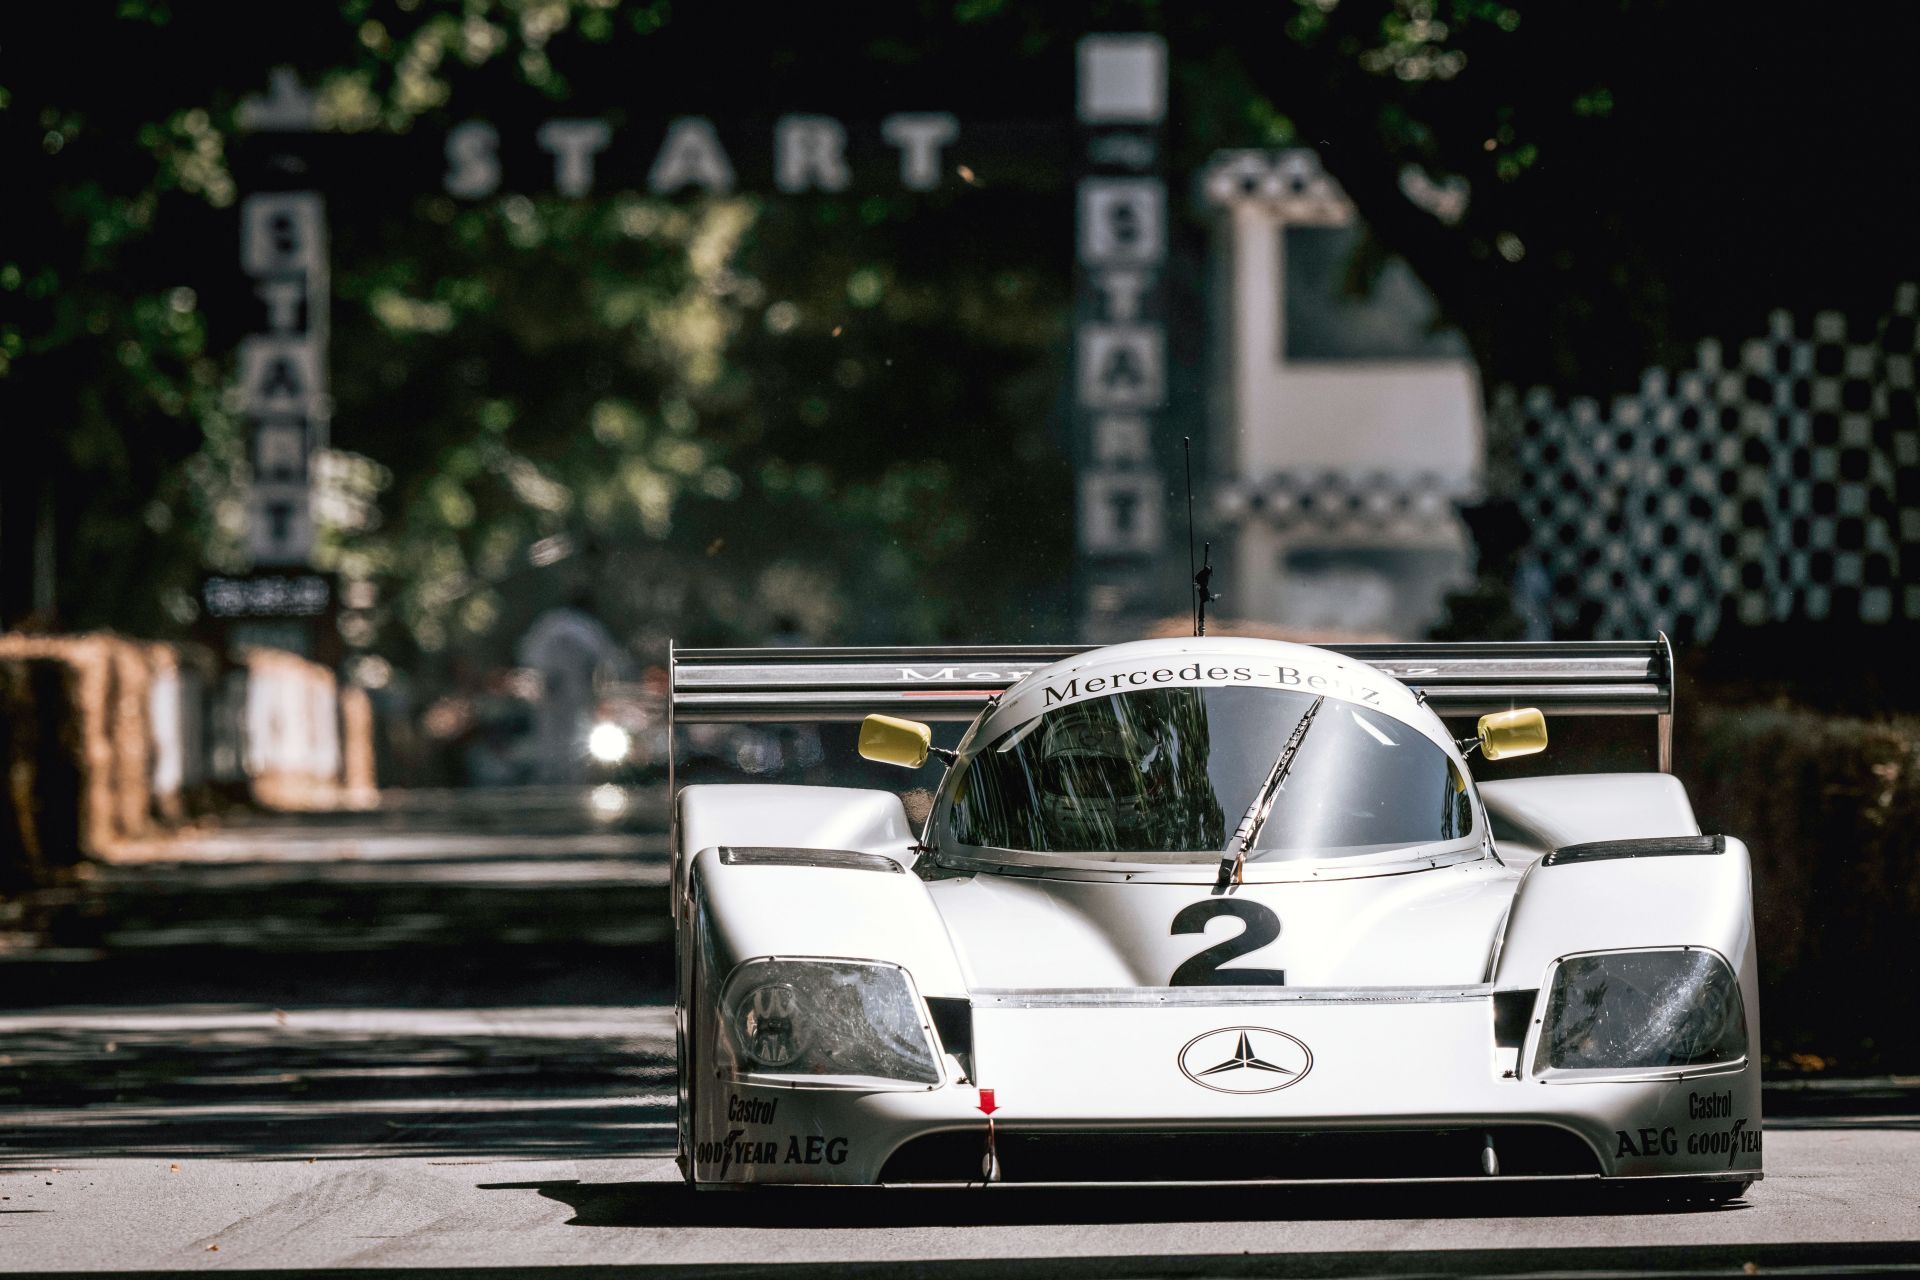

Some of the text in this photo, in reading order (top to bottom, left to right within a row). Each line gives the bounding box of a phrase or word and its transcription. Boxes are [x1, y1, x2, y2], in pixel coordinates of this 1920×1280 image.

[444, 111, 961, 199] START
[1168, 897, 1286, 987] 2
[728, 1094, 779, 1125] Castrol
[1688, 1090, 1732, 1120] Castrol
[784, 1135, 849, 1165] AEG
[1615, 1126, 1678, 1158] AEG
